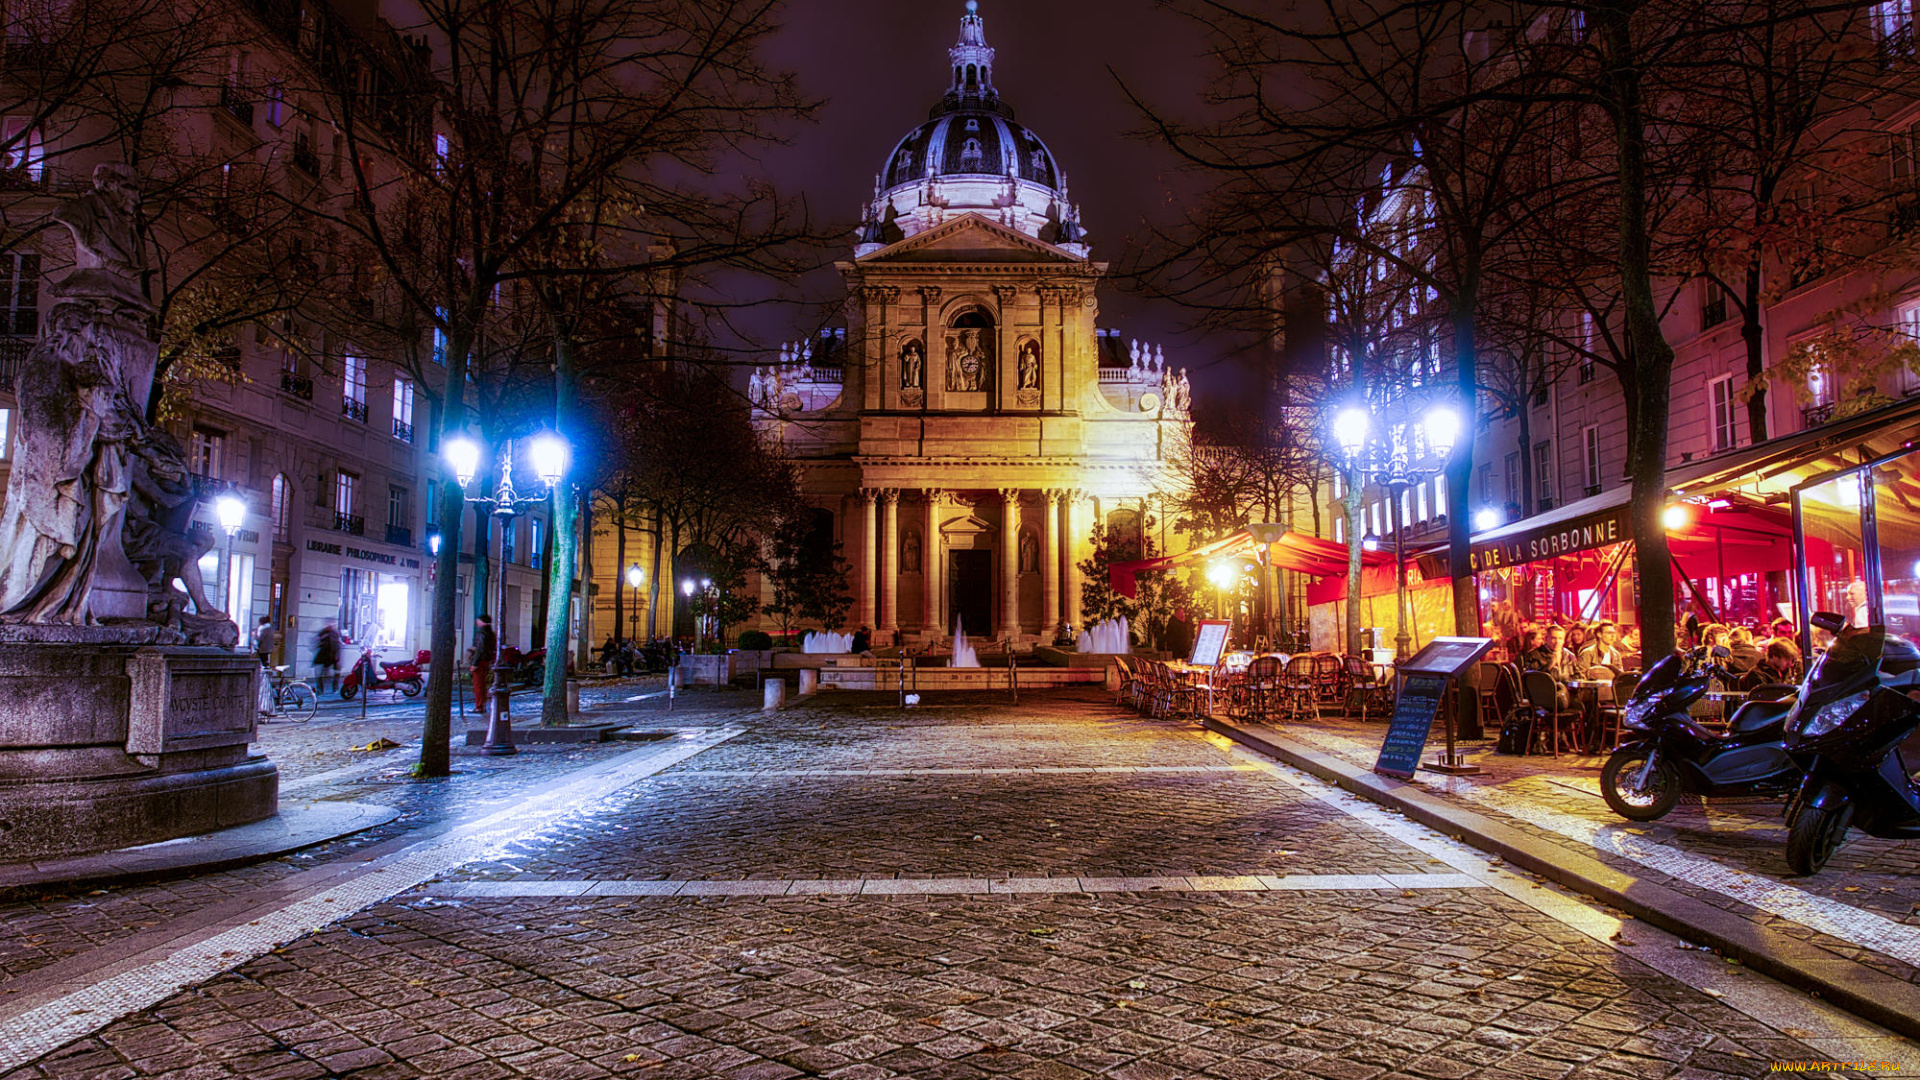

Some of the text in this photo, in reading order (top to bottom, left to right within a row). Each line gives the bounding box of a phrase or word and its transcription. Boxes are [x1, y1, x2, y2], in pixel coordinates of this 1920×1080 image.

[237, 529, 260, 544] VRIN
[1484, 548, 1500, 566] DE
[1507, 544, 1522, 562] LA
[1530, 519, 1617, 558] SORBONNE
[306, 540, 342, 556] LIBRAIRIE
[346, 547, 396, 565] PHILOSOPHIQUE
[406, 558, 420, 569] VRIN
